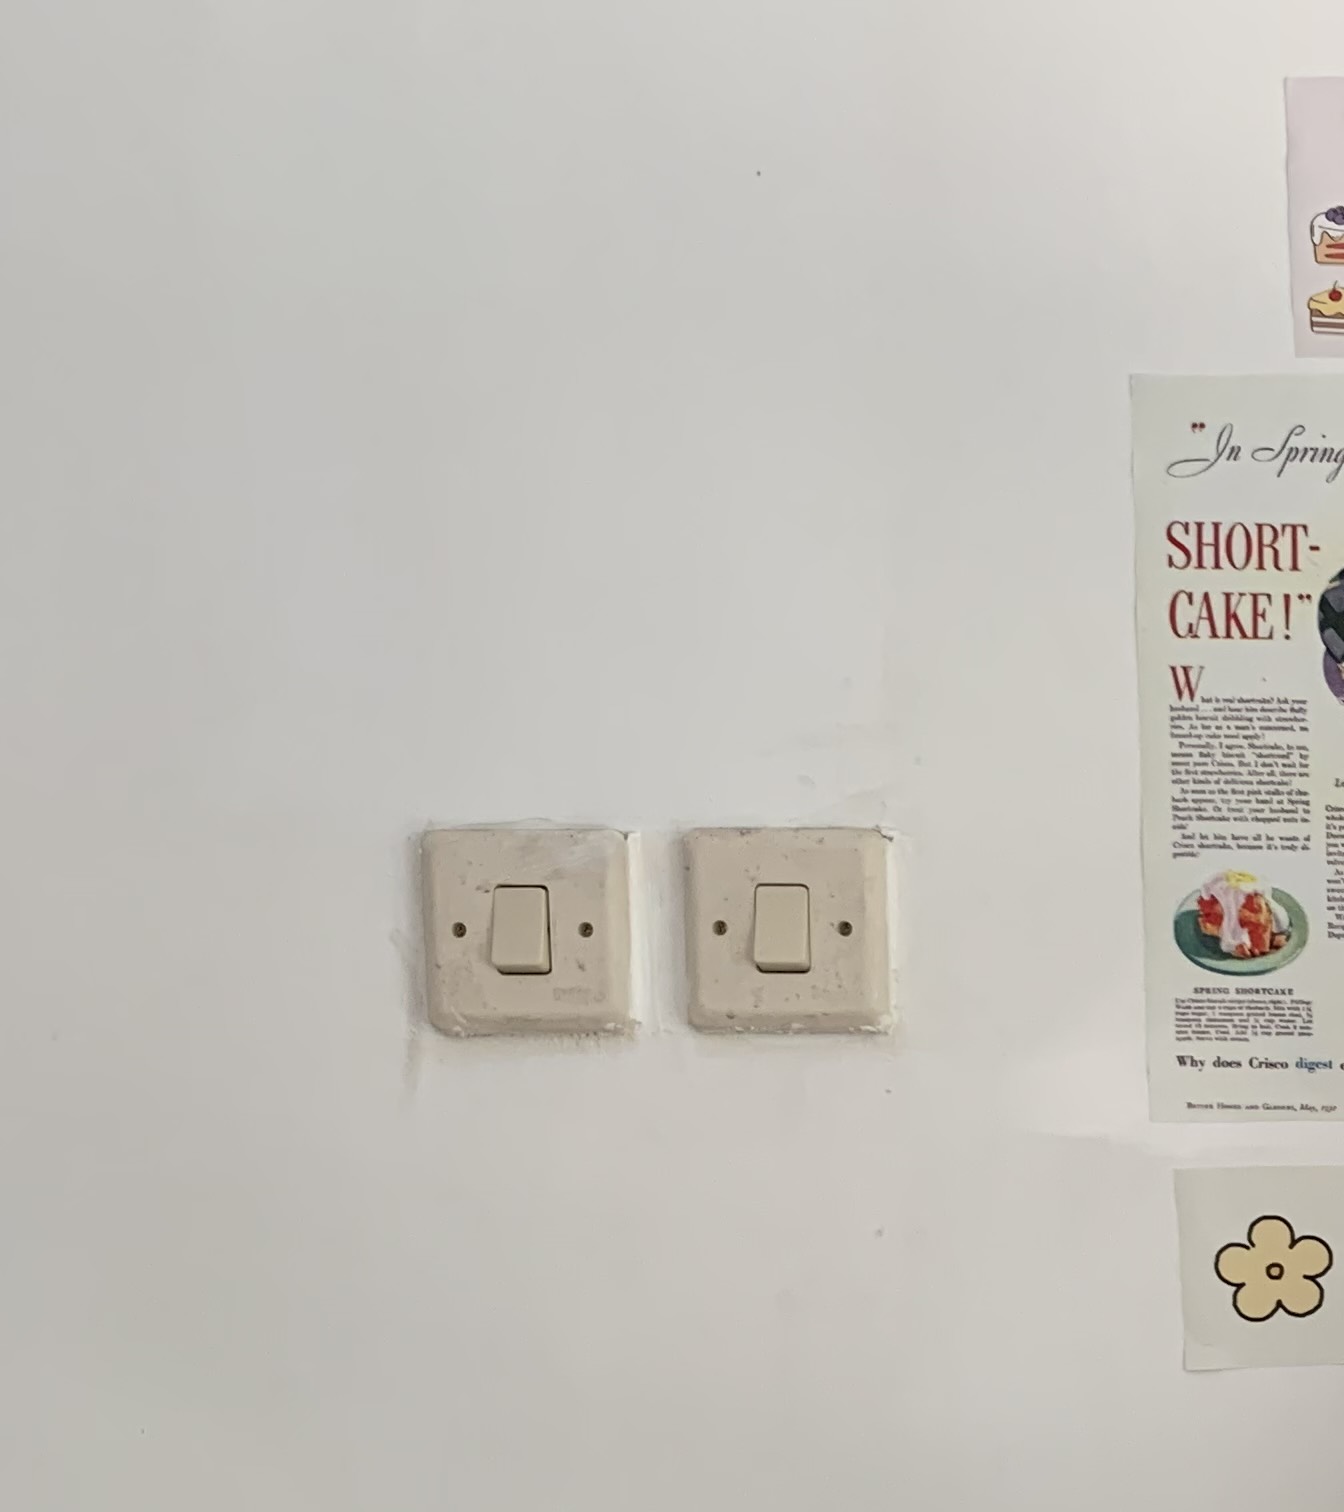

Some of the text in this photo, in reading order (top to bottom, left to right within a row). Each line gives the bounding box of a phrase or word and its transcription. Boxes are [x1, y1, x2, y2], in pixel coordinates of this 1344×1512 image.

[1166, 520, 1320, 572] SHORT-
[1192, 986, 1294, 995] SPRING SHORTCAKE
[1175, 1055, 1206, 1072] Why
[1212, 1055, 1242, 1068] does
[1248, 1056, 1289, 1069] Crisco
[1295, 1056, 1333, 1073] digest
